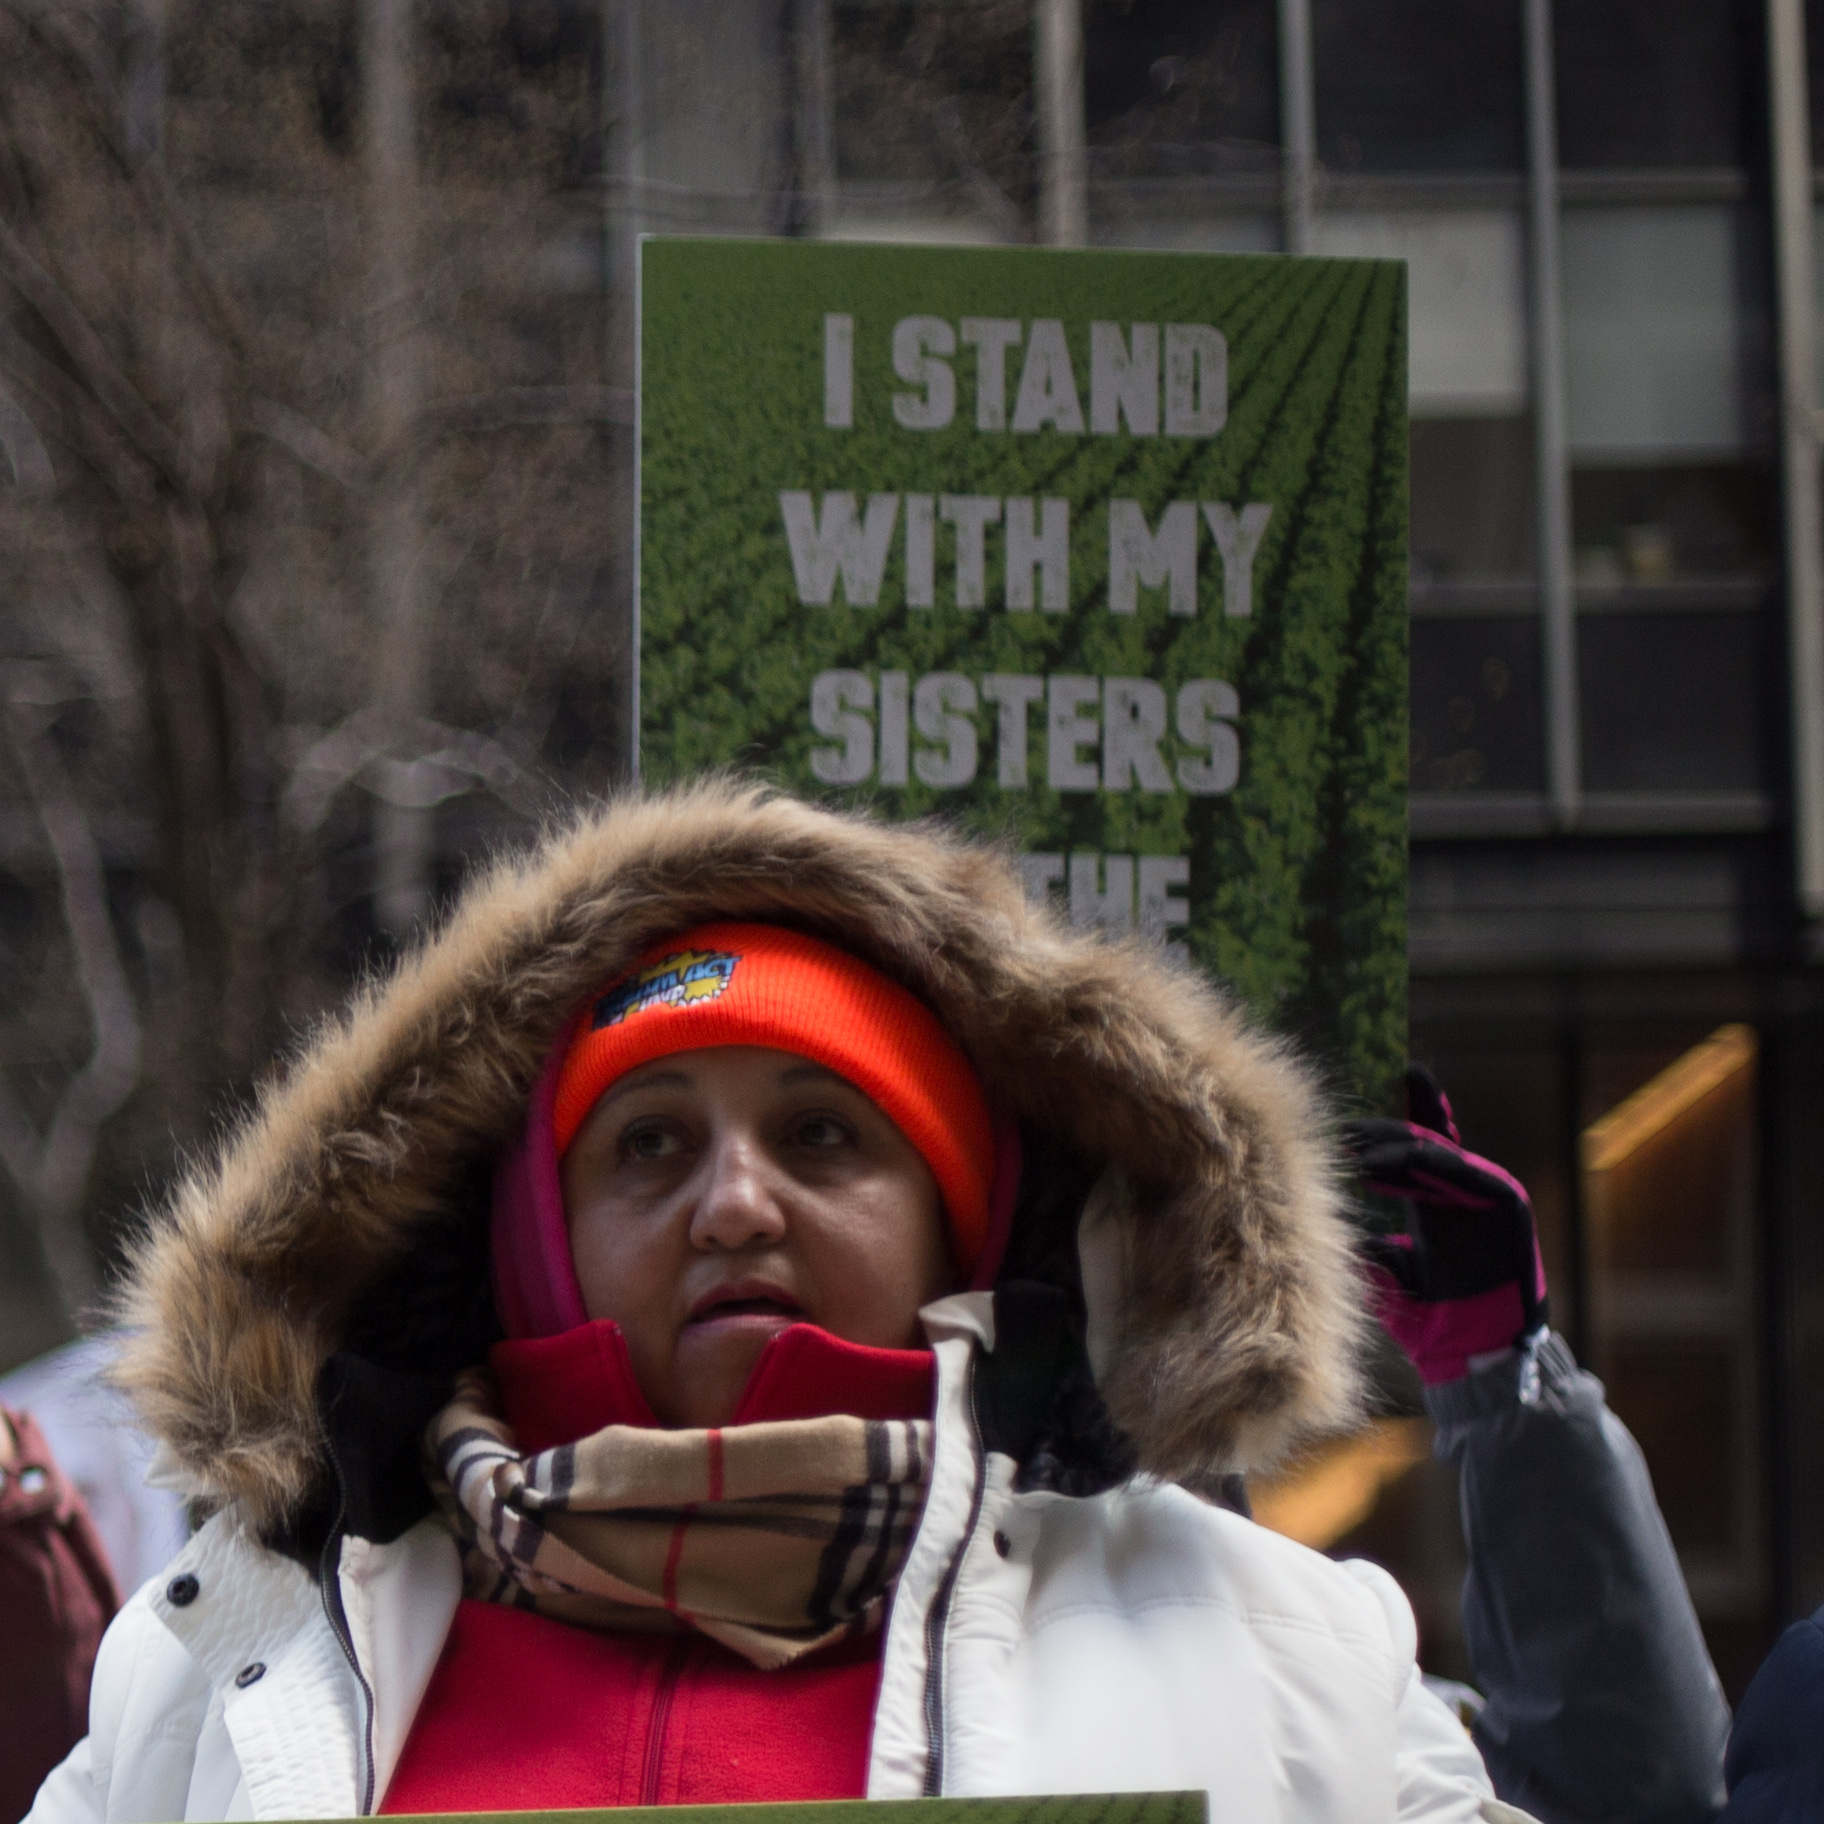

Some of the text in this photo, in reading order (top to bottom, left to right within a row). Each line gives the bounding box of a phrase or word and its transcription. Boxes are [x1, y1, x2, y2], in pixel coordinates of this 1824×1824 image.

[823, 312, 1229, 439] I STAND
[779, 490, 1274, 618] WITH MY
[810, 669, 1240, 795] SISTERS
